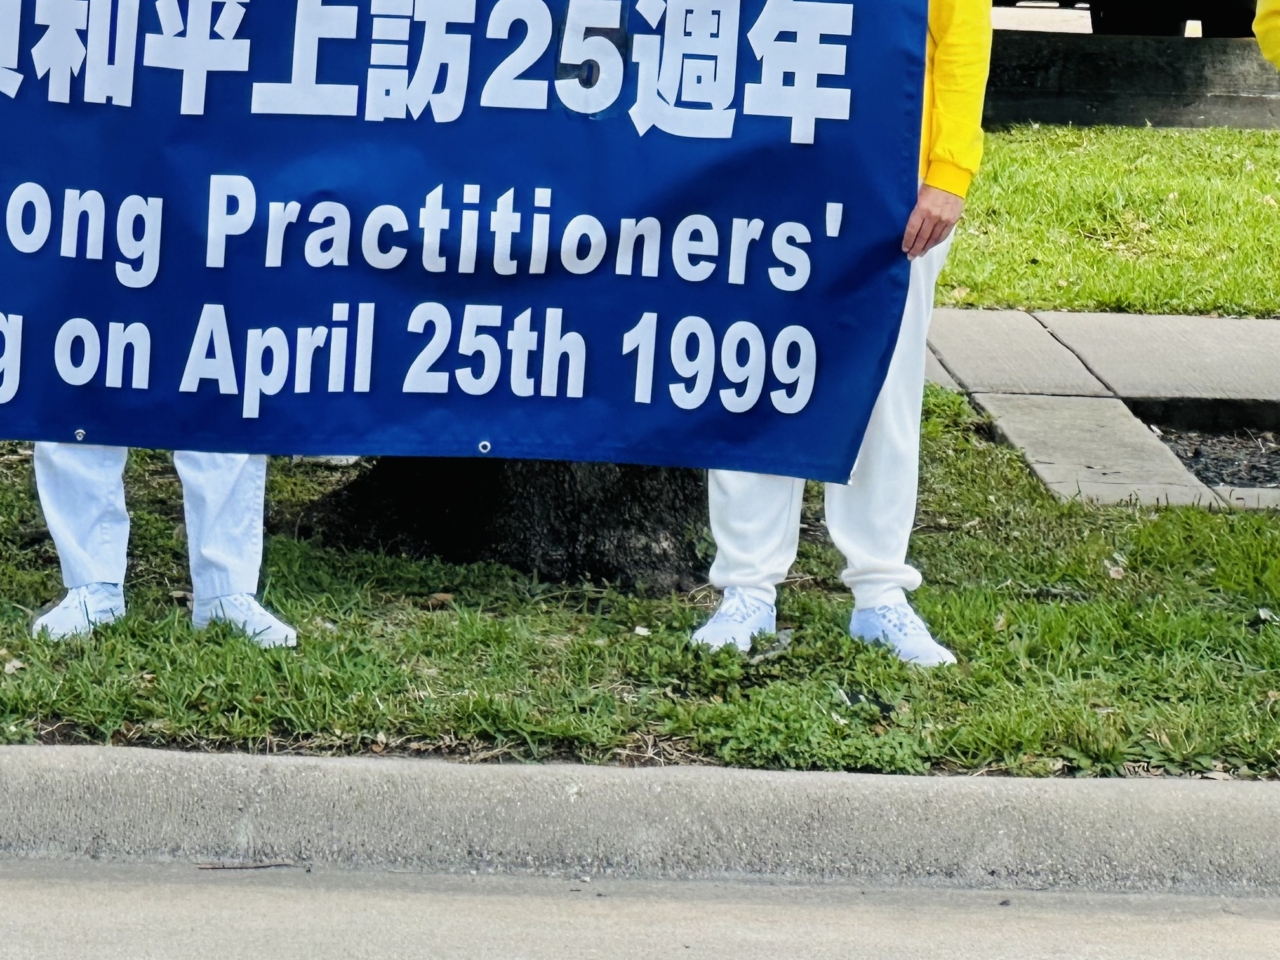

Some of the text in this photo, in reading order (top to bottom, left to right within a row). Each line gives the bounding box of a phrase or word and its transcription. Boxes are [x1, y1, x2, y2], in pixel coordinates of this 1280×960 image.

[206, 174, 843, 291] Practitioners'
[54, 317, 151, 389] on
[179, 302, 374, 417] April
[402, 302, 586, 398] 25th
[622, 312, 816, 414] 1999
